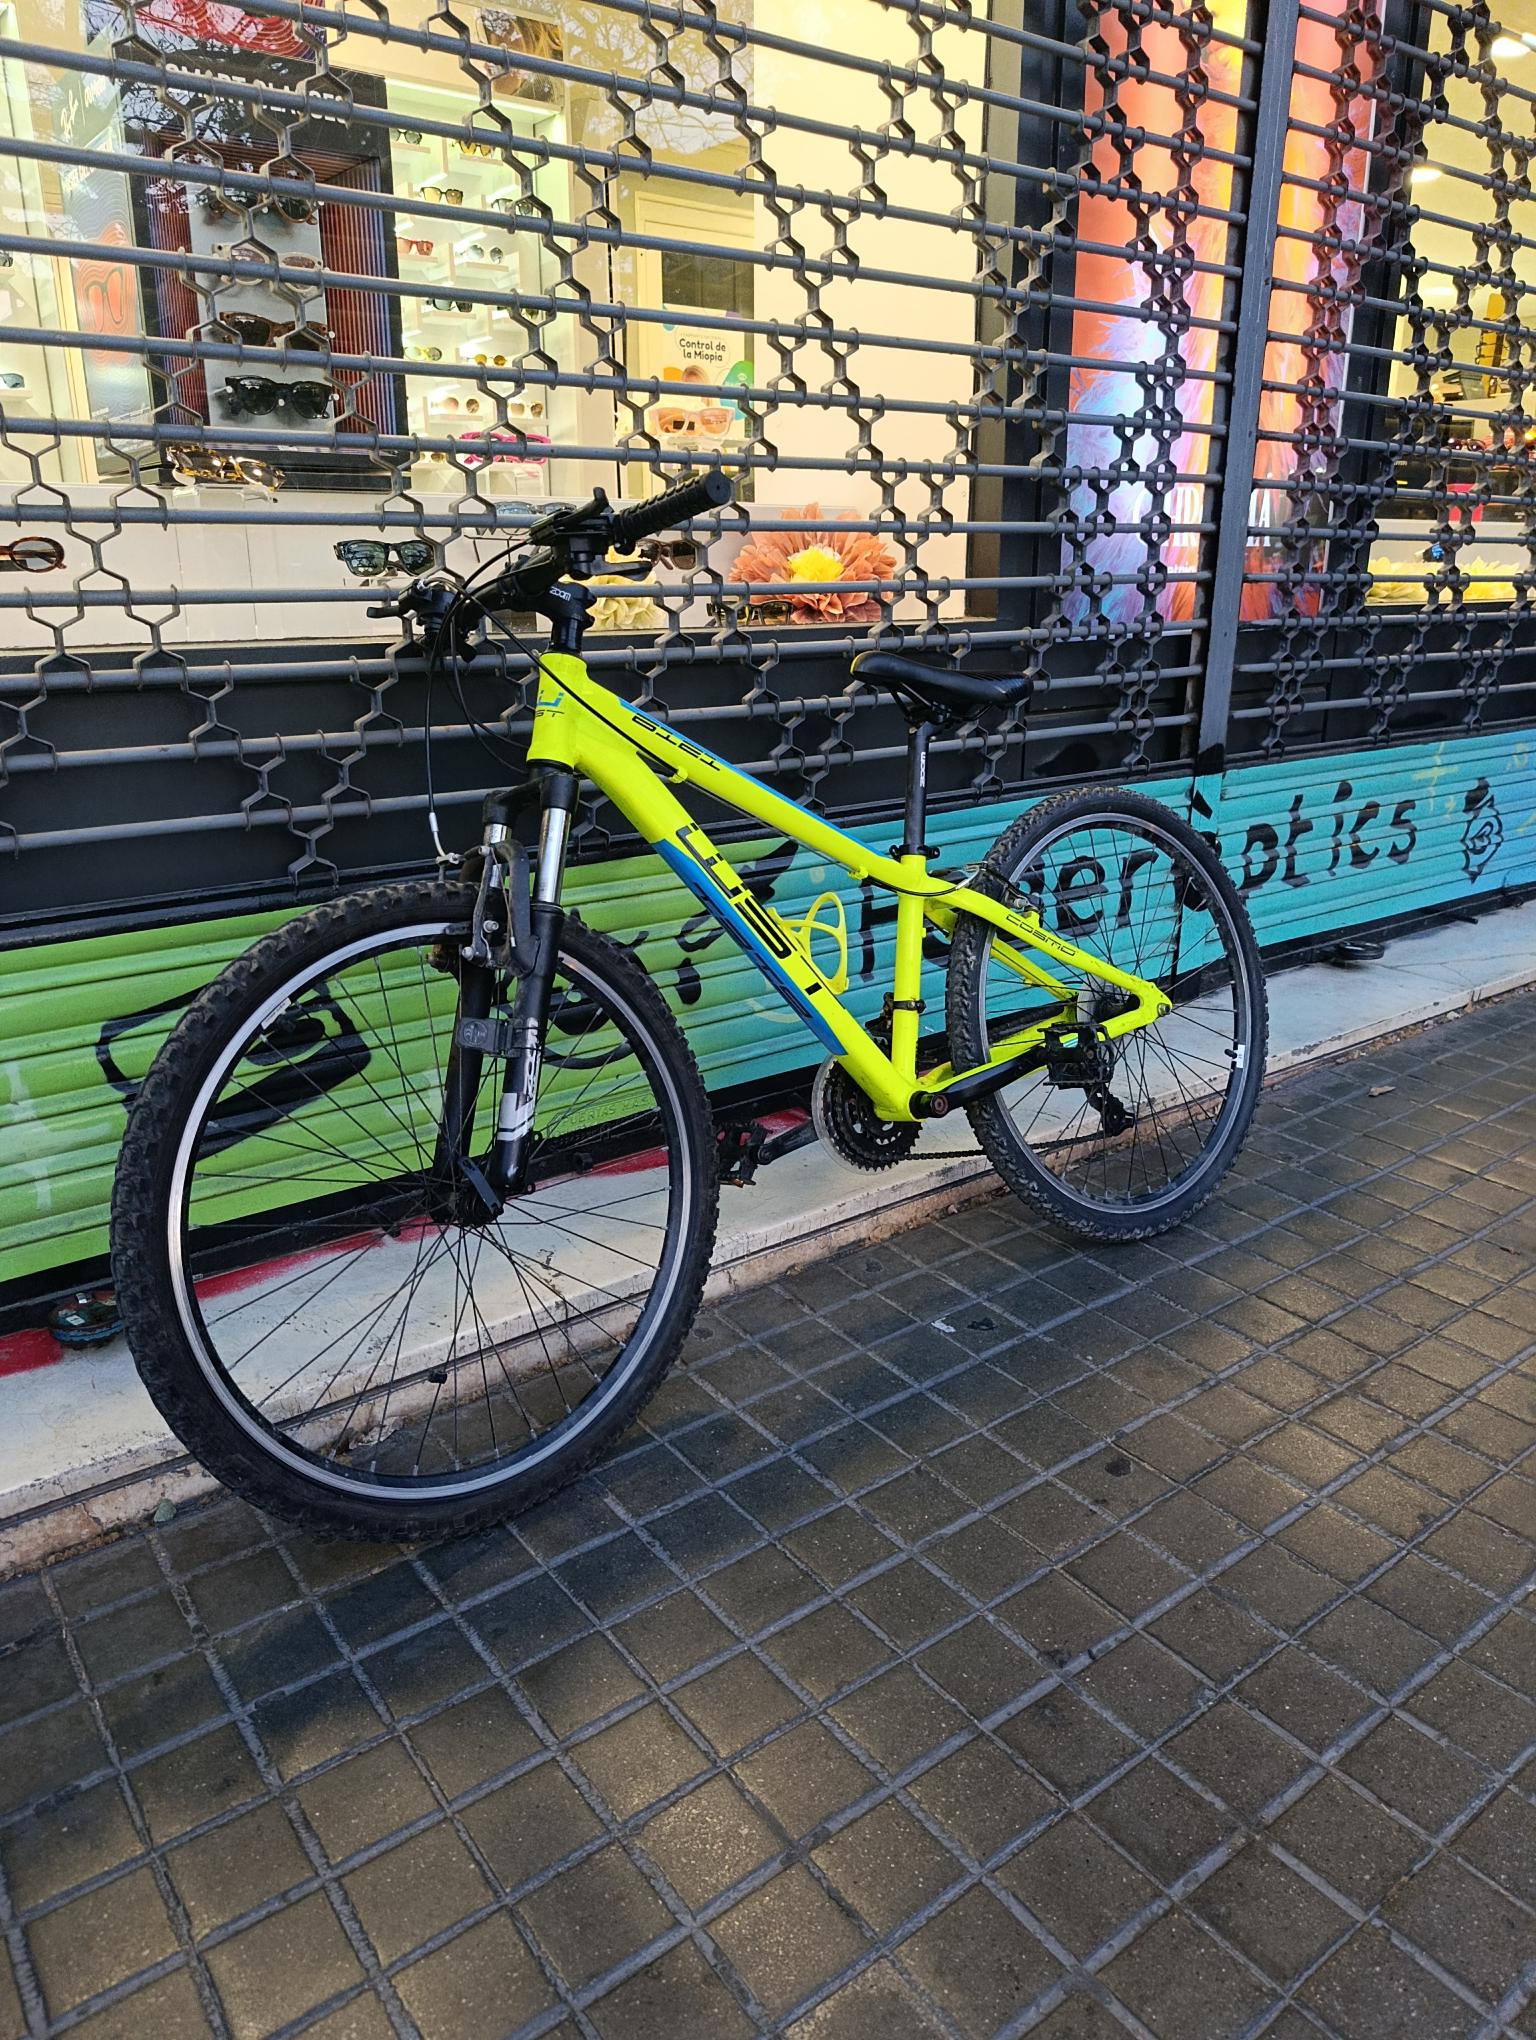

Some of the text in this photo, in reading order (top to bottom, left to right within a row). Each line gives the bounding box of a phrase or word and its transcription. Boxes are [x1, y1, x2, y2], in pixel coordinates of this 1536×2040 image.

[679, 338, 726, 352] Control de
[683, 349, 723, 363] la Miopia
